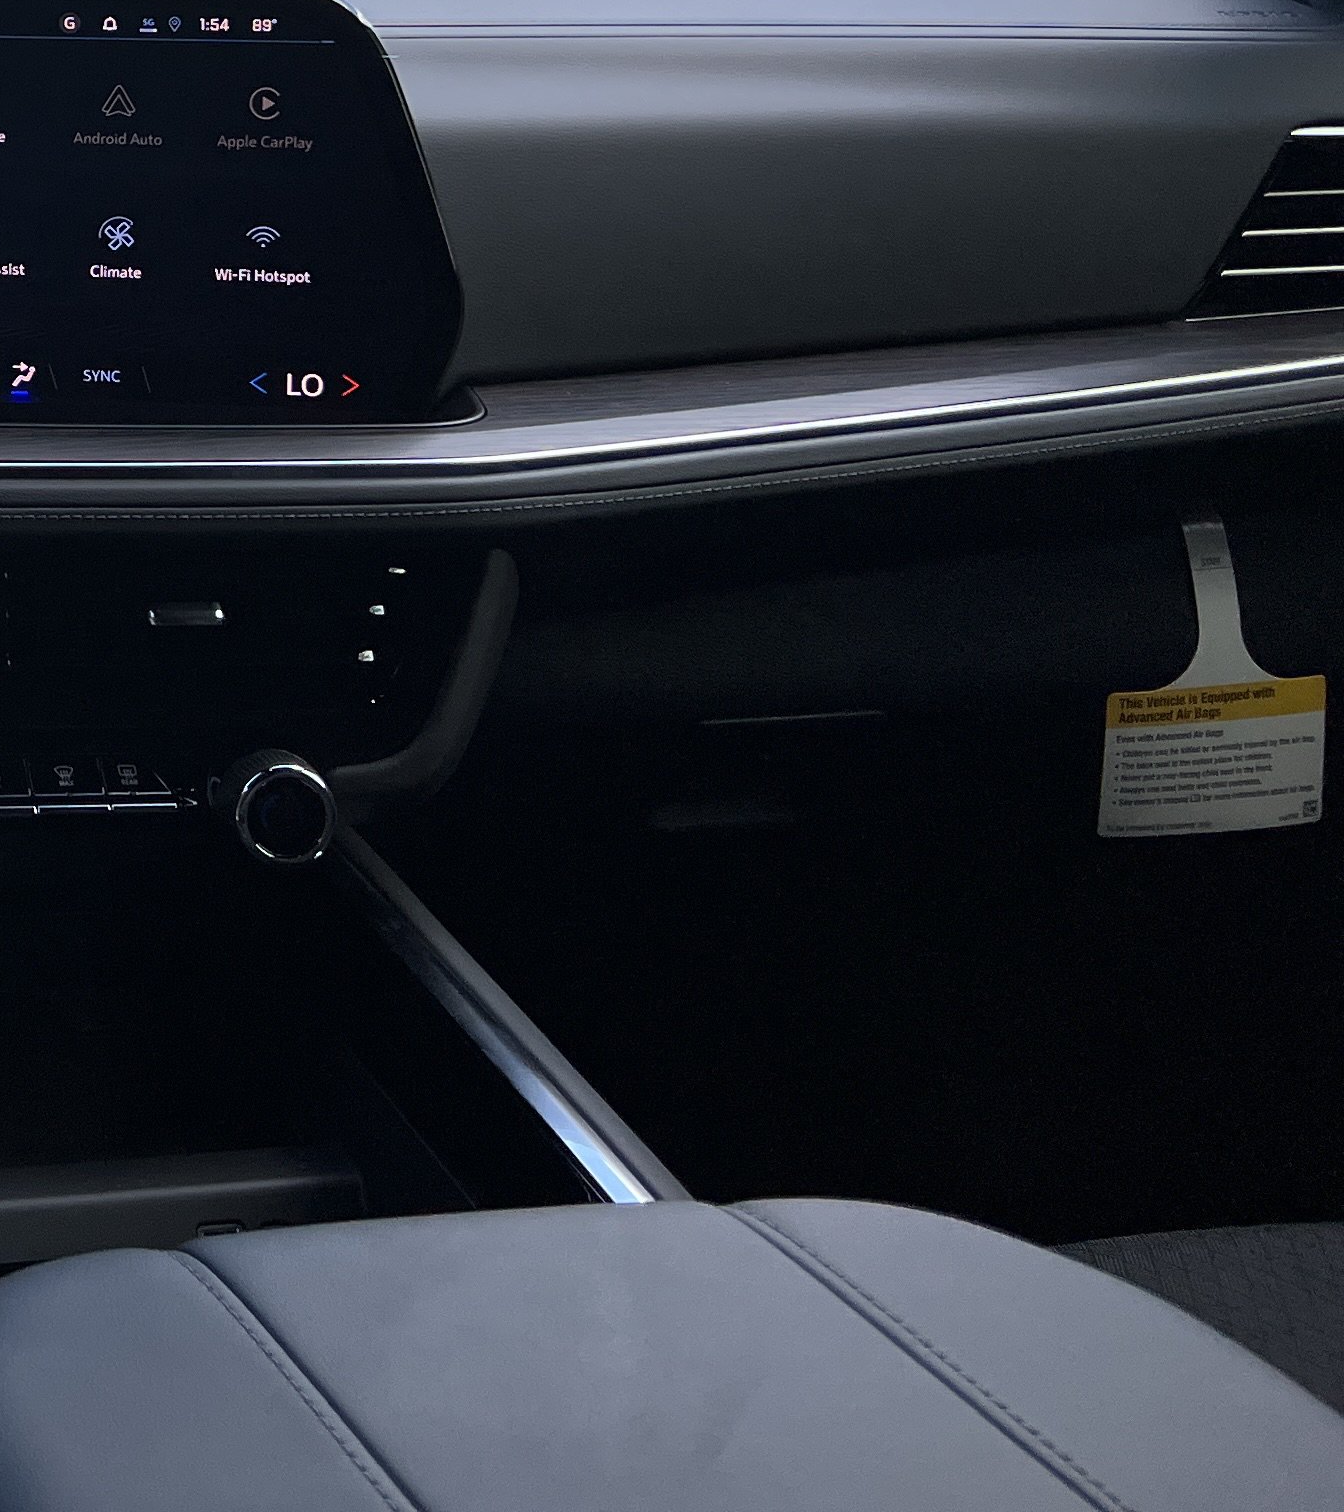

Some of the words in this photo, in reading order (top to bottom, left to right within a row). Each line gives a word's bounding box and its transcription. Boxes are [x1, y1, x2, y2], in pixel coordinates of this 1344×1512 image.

[199, 17, 230, 32] 1:54
[73, 131, 126, 146] Android
[130, 133, 163, 147] Auto
[217, 135, 259, 152] Apple
[261, 135, 313, 153] CarPlay
[89, 264, 142, 280] Climate
[214, 268, 251, 283] Wi-Fi
[254, 269, 312, 286] Hotspot
[83, 368, 121, 384] SYNC
[286, 373, 324, 398] LO
[1119, 697, 1143, 710] This
[1147, 694, 1186, 708] Vehicle
[1189, 694, 1198, 705] is
[1201, 688, 1250, 705] Equipped
[1253, 686, 1276, 699] with
[1118, 708, 1173, 724] Advanced
[1176, 707, 1192, 719] Air
[1194, 706, 1222, 721] Bags
